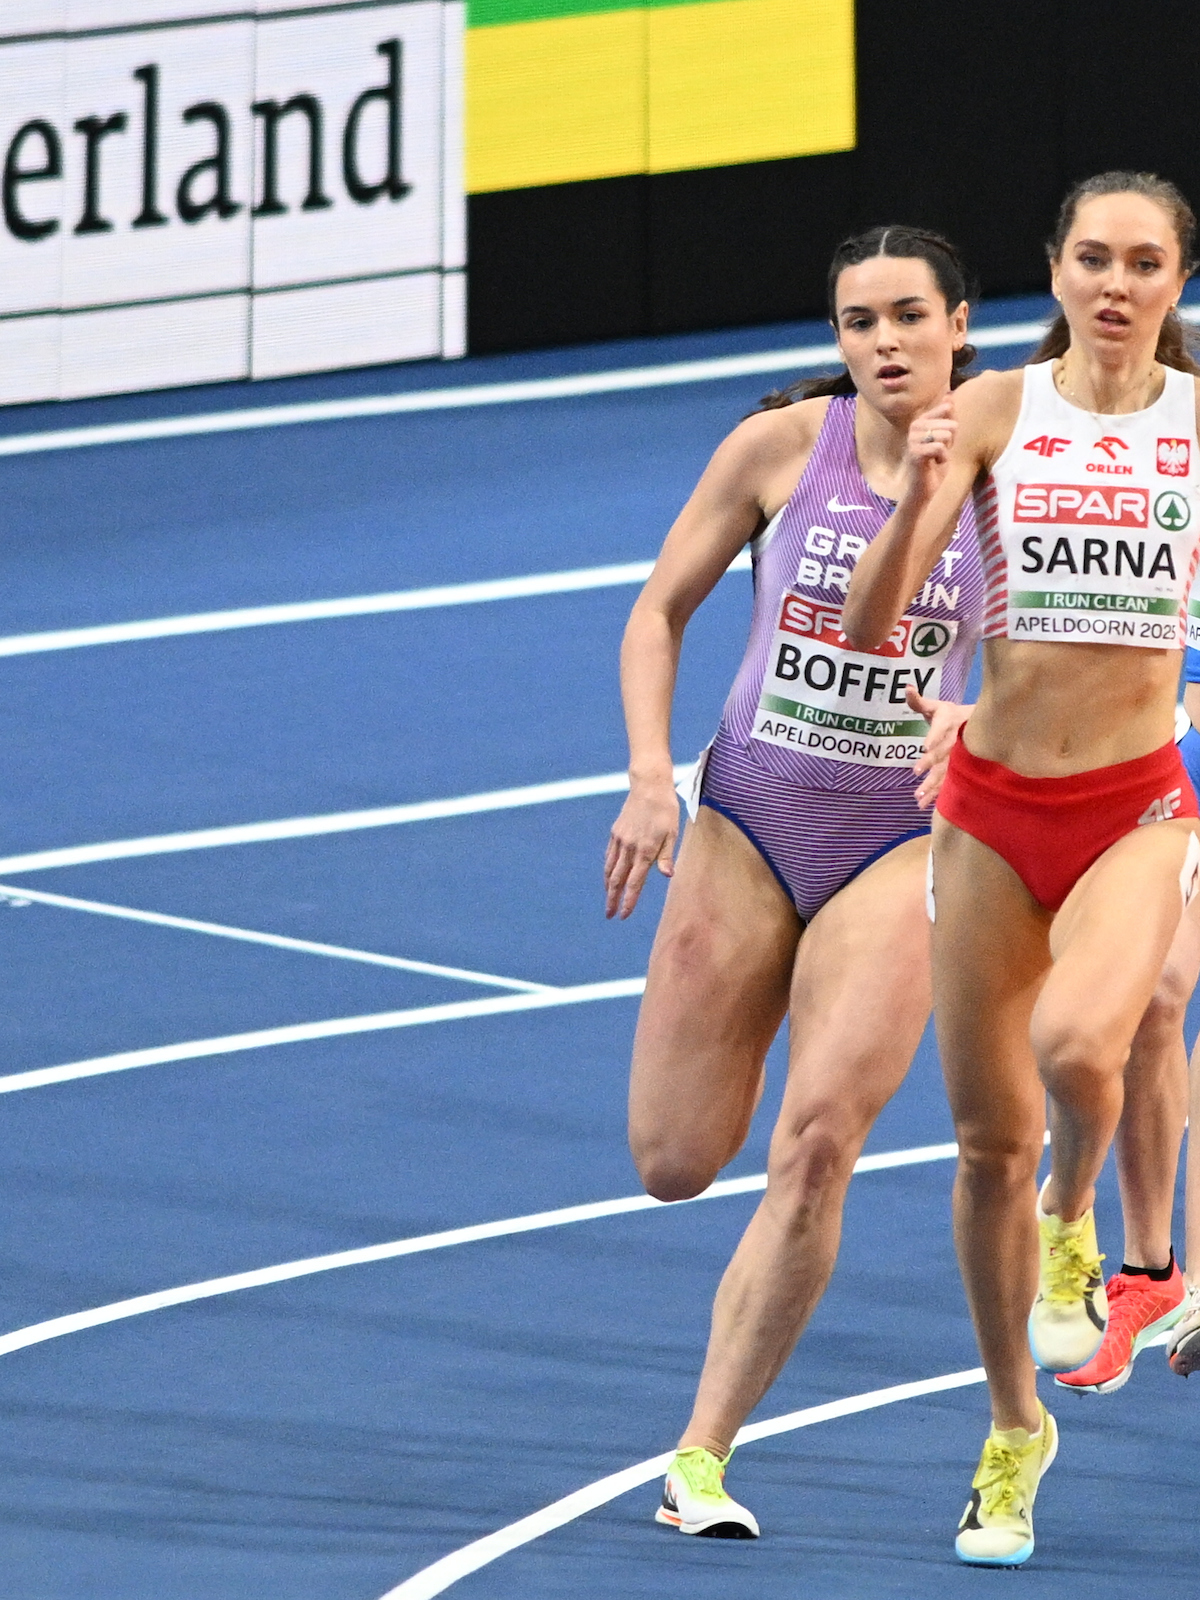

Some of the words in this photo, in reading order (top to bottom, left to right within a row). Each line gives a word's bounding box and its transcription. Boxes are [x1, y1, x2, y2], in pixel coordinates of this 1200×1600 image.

[2, 38, 412, 242] erland
[1086, 463, 1133, 476] ORLEN
[1017, 488, 1147, 523] SPAR
[1021, 536, 1177, 581] SARNA
[1045, 593, 1050, 607] I
[1053, 593, 1091, 608] RUN
[784, 600, 907, 653] SPR
[1015, 617, 1136, 637] APELDOORN
[1140, 622, 1177, 640] 2025
[775, 643, 936, 704] BOFFEY
[796, 704, 802, 718] I
[803, 707, 840, 728] RUN
[760, 719, 882, 760] APELDOORN
